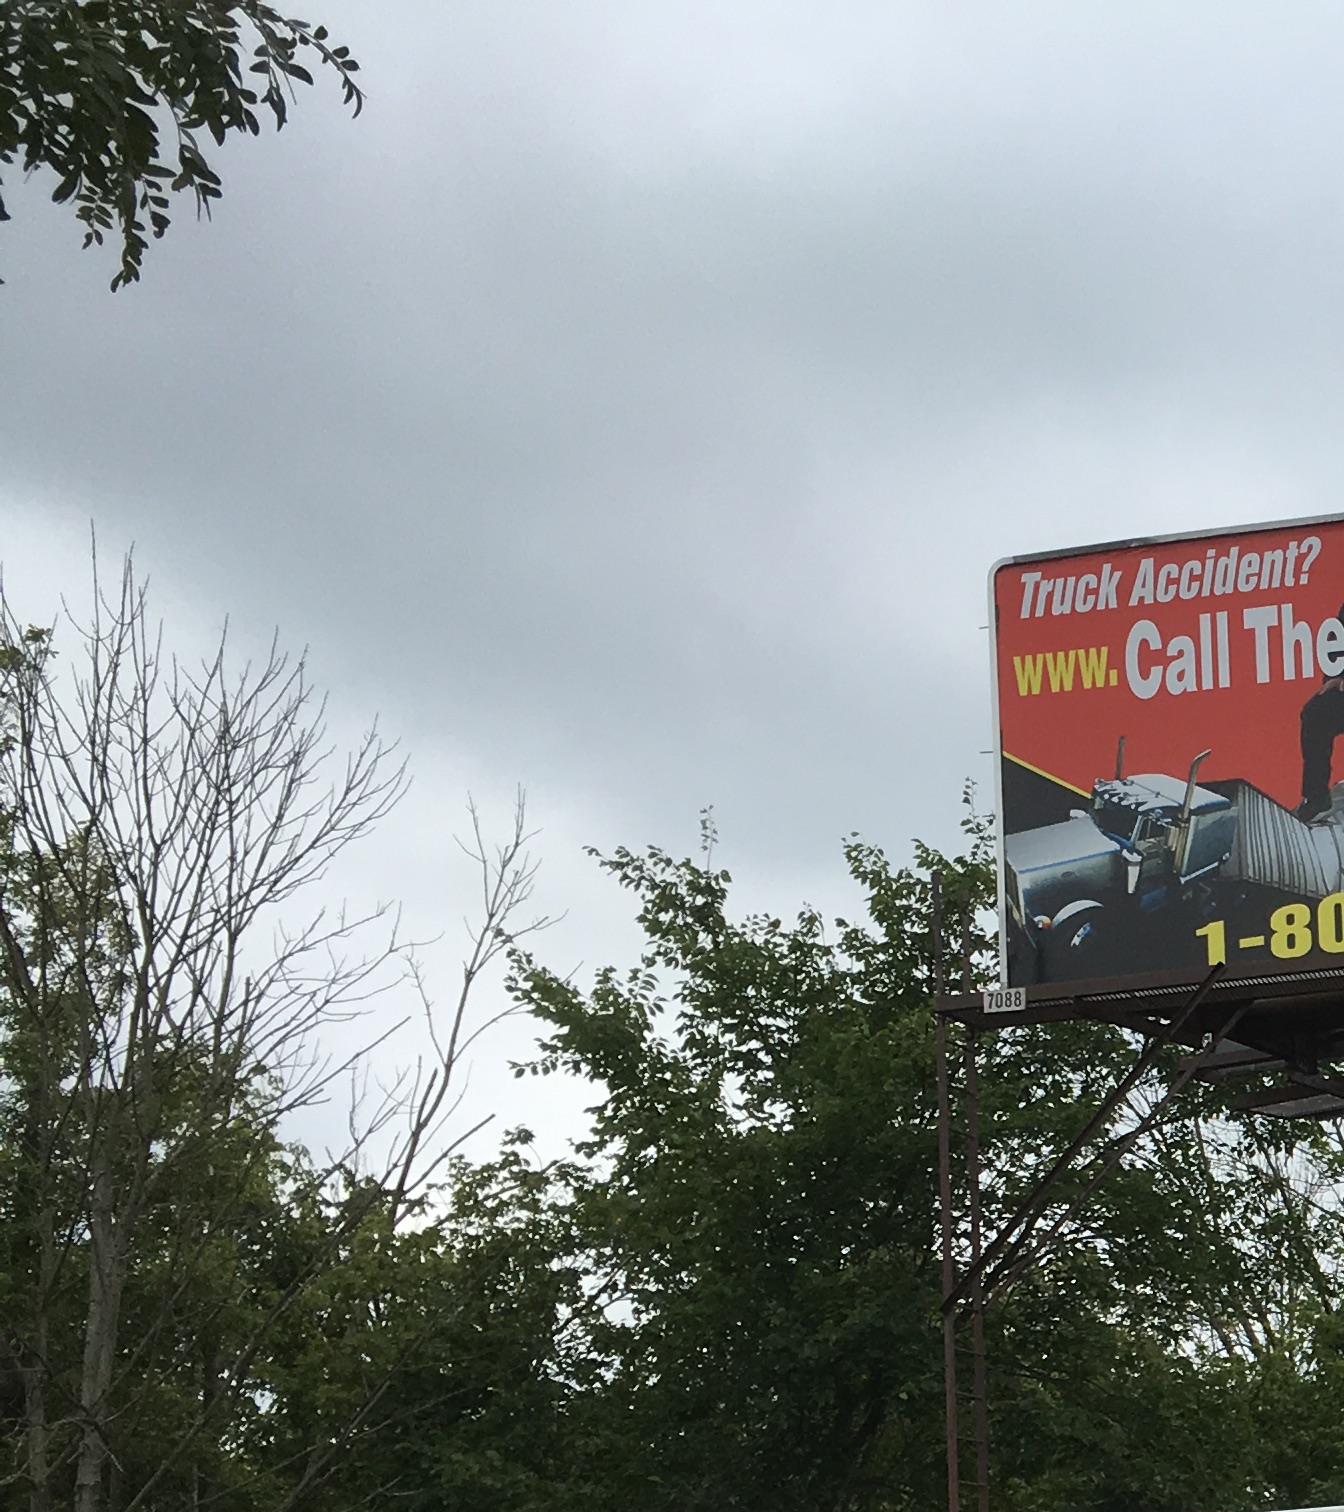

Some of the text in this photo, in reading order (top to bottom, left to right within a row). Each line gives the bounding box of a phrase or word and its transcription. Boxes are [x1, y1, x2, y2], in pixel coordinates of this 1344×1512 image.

[1019, 537, 1321, 619] Truck Accident?
[987, 991, 1022, 1009] 7088
